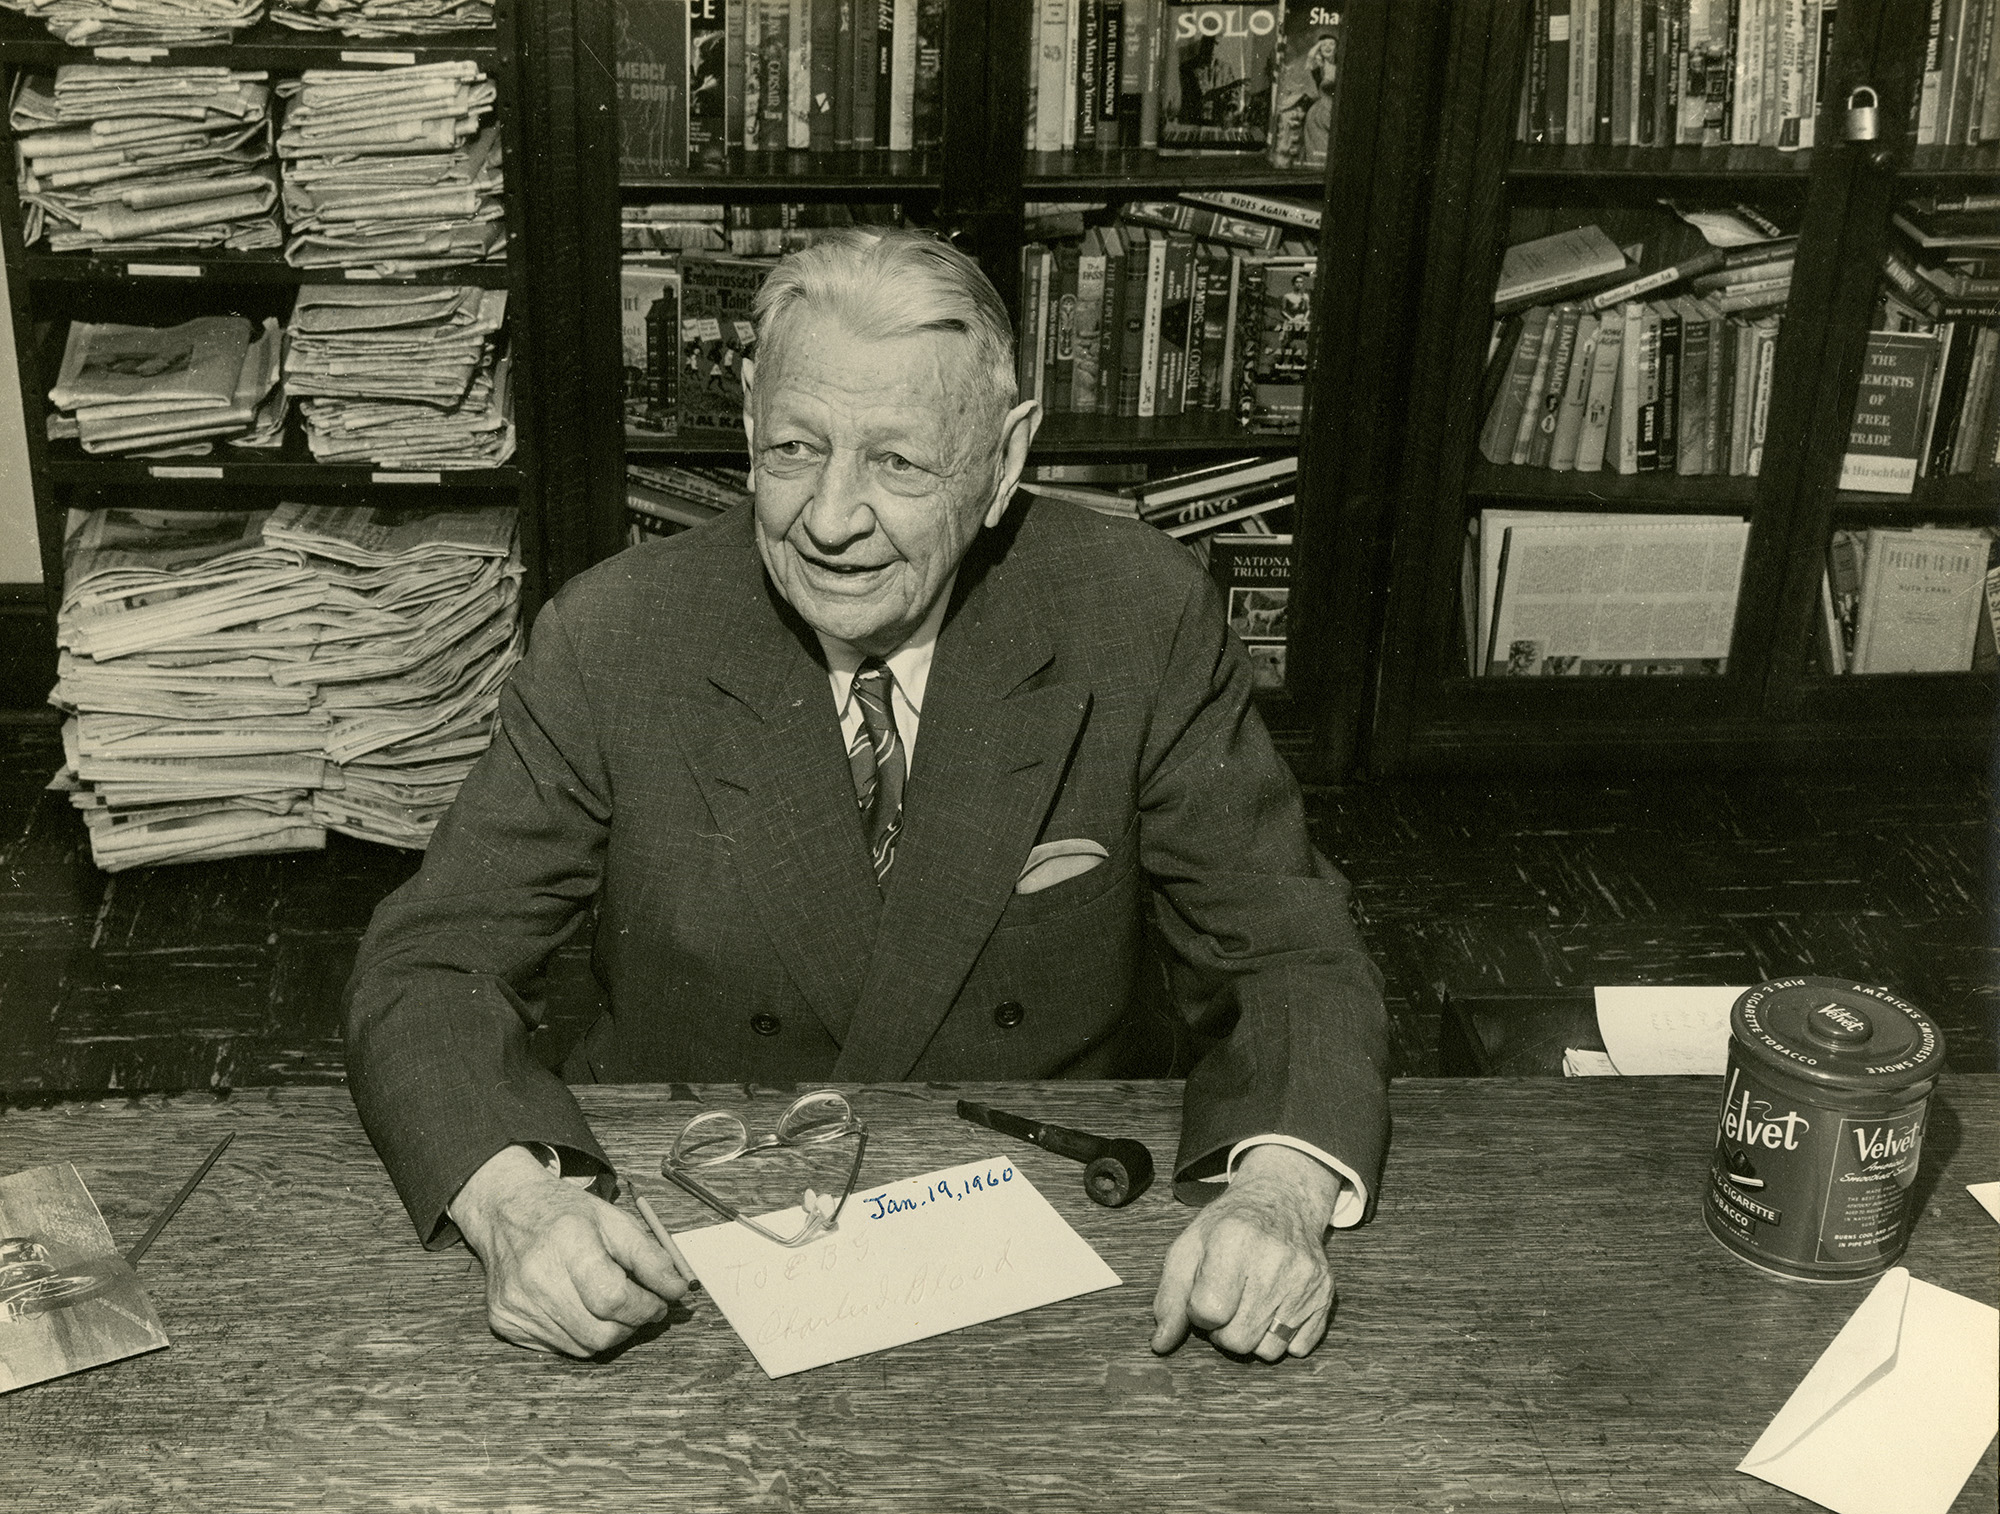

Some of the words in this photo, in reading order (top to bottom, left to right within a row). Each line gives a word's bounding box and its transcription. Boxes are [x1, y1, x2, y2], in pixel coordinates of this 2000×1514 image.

[1175, 9, 1275, 41] SOLO
[1309, 7, 1340, 26] Sha
[1108, 20, 1117, 39] LIVE
[1107, 41, 1117, 59] TILL
[1783, 30, 1796, 67] LIGHTS
[616, 61, 667, 80] MERCY
[1082, 39, 1097, 87] Manage
[631, 83, 678, 102] COURT
[767, 60, 781, 107] CORSAIR
[1105, 61, 1116, 116] TOMORROW
[1781, 80, 1789, 100] your
[1084, 87, 1097, 134] Yourself
[1230, 196, 1256, 211] RIDES
[1260, 204, 1288, 218] AGAIN
[1082, 270, 1104, 281] PASS
[1193, 277, 1207, 324] MEMOIRS
[1549, 324, 1574, 395] HAMTRAMCK
[1647, 324, 1658, 380] APPOINTMENT
[1871, 354, 1897, 367] THE
[1187, 348, 1202, 390] CONSUL
[1868, 394, 1886, 406] OF
[1644, 406, 1655, 442] FORTUNE
[1857, 413, 1891, 427] FREE
[1850, 433, 1892, 447] TRADE
[1853, 465, 1912, 480] Hirschfeld
[1179, 497, 1238, 523] dive
[1233, 556, 1291, 566] NATIONA
[1233, 567, 1268, 577] TRIAL
[1270, 567, 1291, 577] CH
[1774, 979, 1806, 990] PIPE
[1744, 992, 1765, 1034] CIGARETTE
[1852, 984, 1921, 1020] AMERICA'S
[1818, 1002, 1865, 1032] Velvet
[1760, 1034, 1818, 1066] TOBACCO
[1912, 1021, 1935, 1064] SMOOTHEST
[1865, 1060, 1914, 1075] SMOKE
[1853, 1122, 1920, 1161] Velvet
[1840, 1170, 1895, 1182] Smoothest
[1712, 1189, 1749, 1227] TOBACCO
[1723, 1183, 1775, 1221] CIGARETTE
[1847, 1240, 1863, 1248] PIPE
[1875, 1228, 1888, 1236] AND
